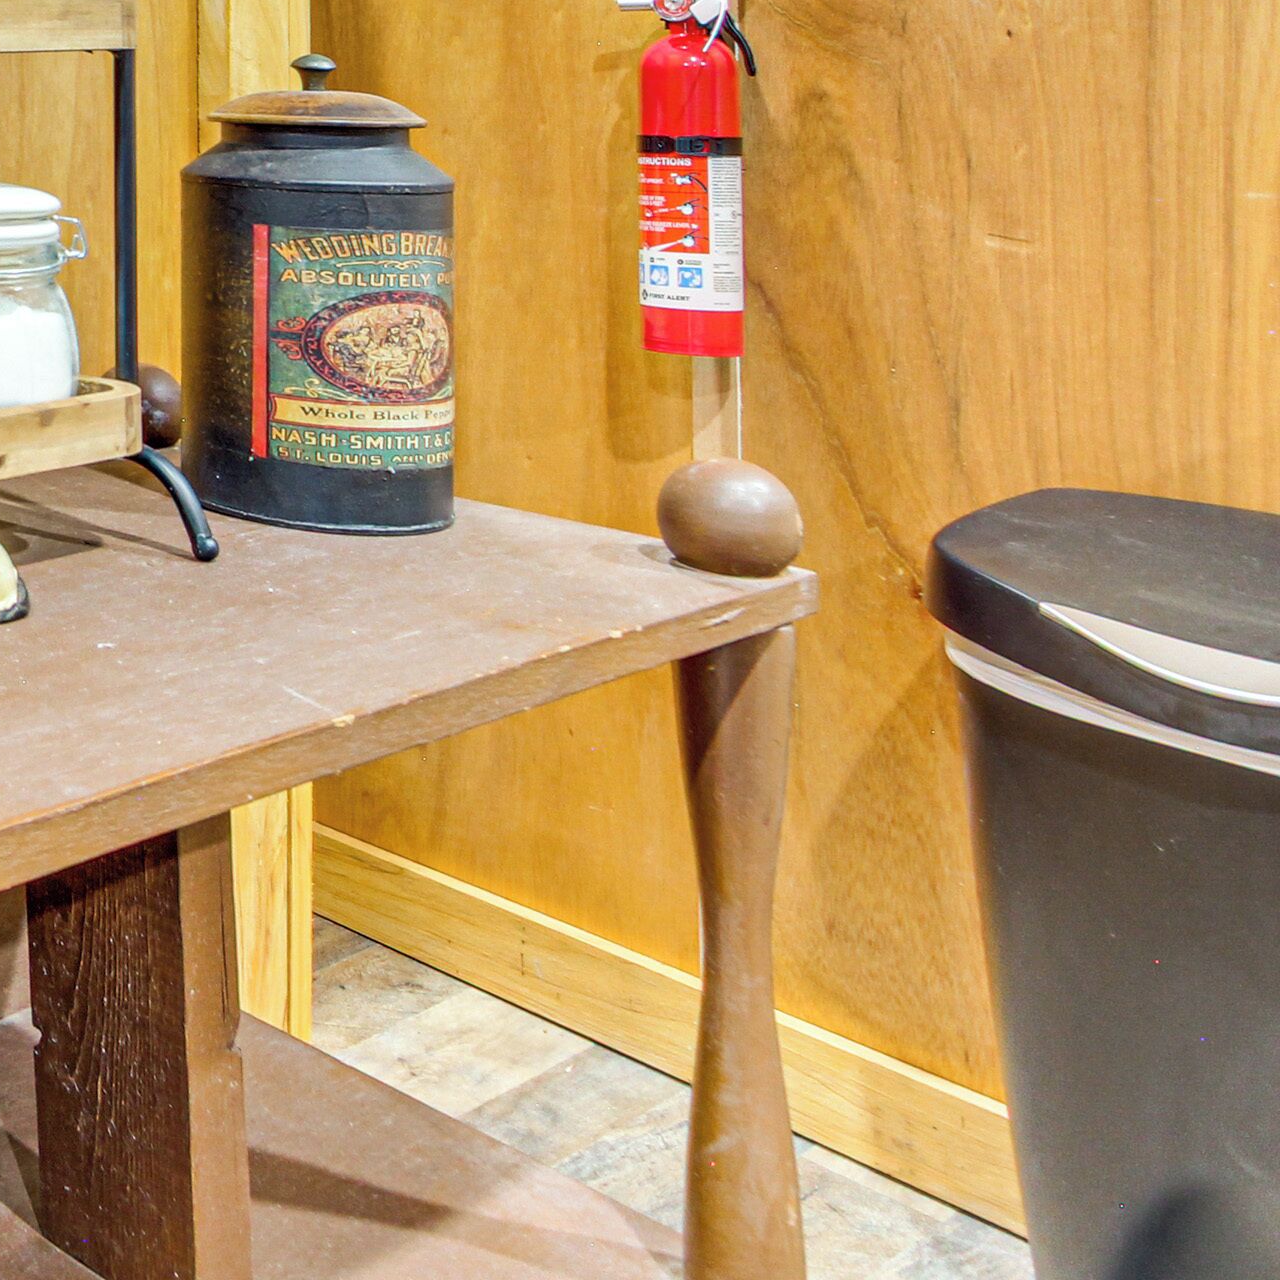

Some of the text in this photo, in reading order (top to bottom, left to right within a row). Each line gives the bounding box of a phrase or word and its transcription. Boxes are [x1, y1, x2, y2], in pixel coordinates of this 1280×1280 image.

[271, 232, 397, 264] WEDDING
[280, 268, 431, 287] ABSOLUTELY
[300, 405, 366, 420] Whole
[373, 410, 419, 421] Black
[434, 433, 443, 448] &
[278, 446, 310, 460] ST.
[316, 451, 382, 466] LOUIS
